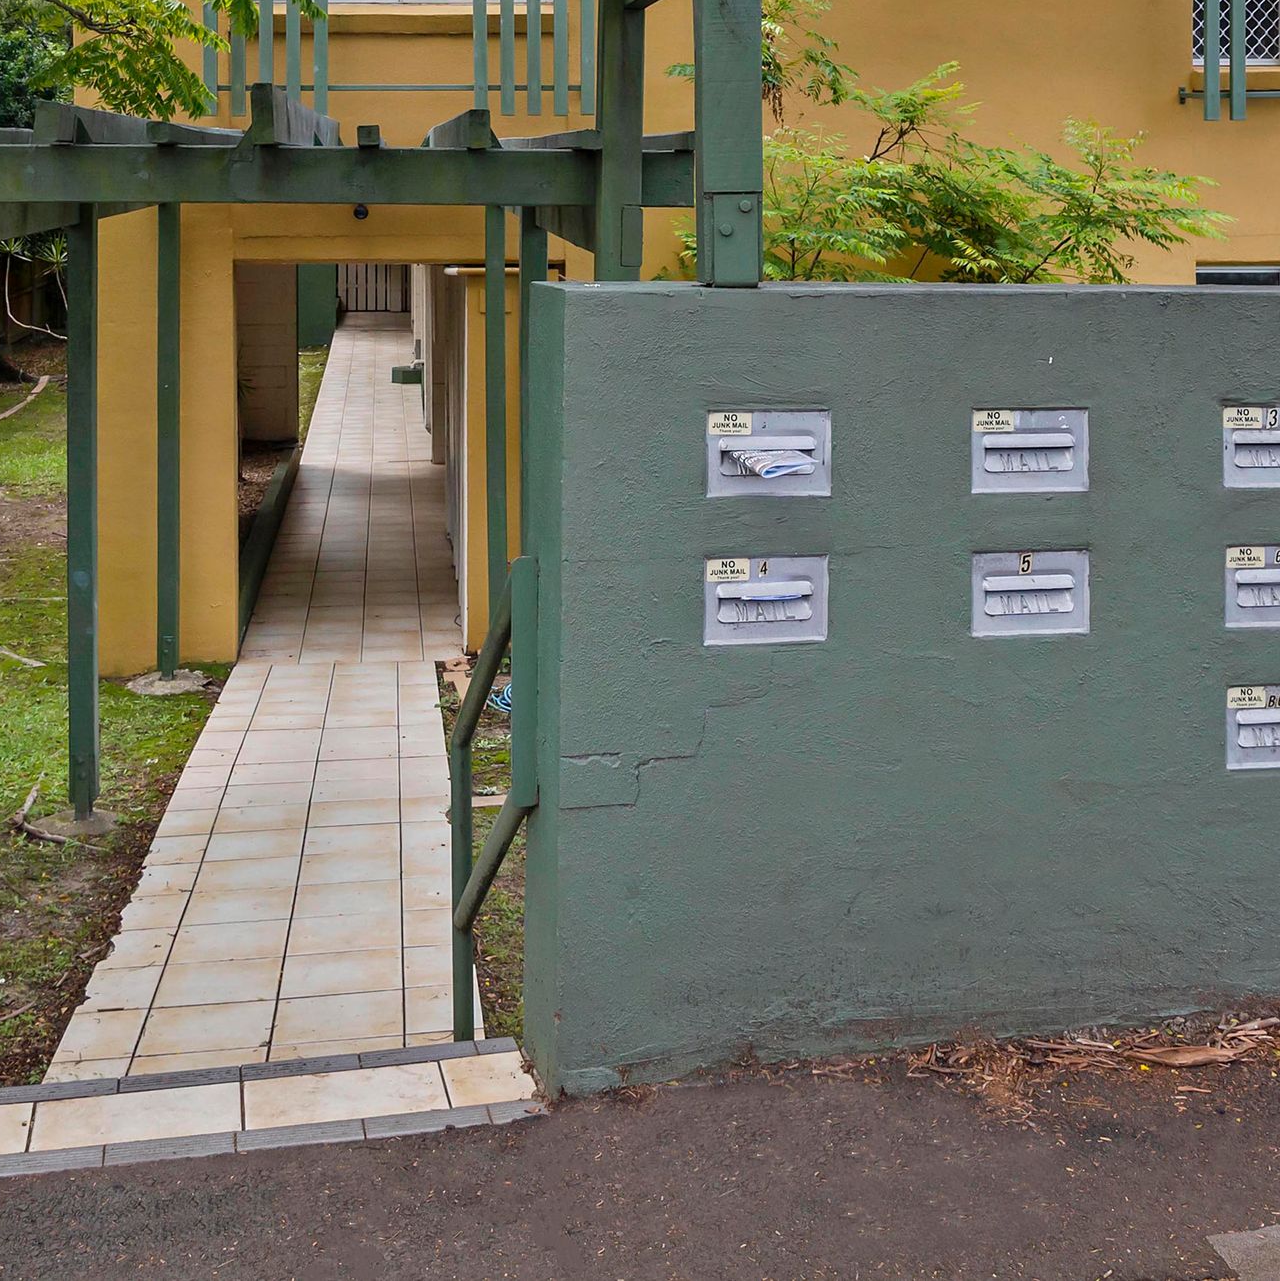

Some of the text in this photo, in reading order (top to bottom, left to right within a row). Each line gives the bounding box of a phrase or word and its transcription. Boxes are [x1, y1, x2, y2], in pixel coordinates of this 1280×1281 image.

[724, 414, 738, 422] NO
[1269, 409, 1278, 427] 3
[1000, 453, 1059, 471] MAIL
[1239, 548, 1252, 556] NO
[721, 560, 735, 568] NO
[760, 561, 768, 575] 4
[1021, 554, 1032, 573] 5
[734, 601, 796, 621] MAIL
[1000, 594, 1059, 614] MAIL
[1240, 688, 1253, 696] NO
